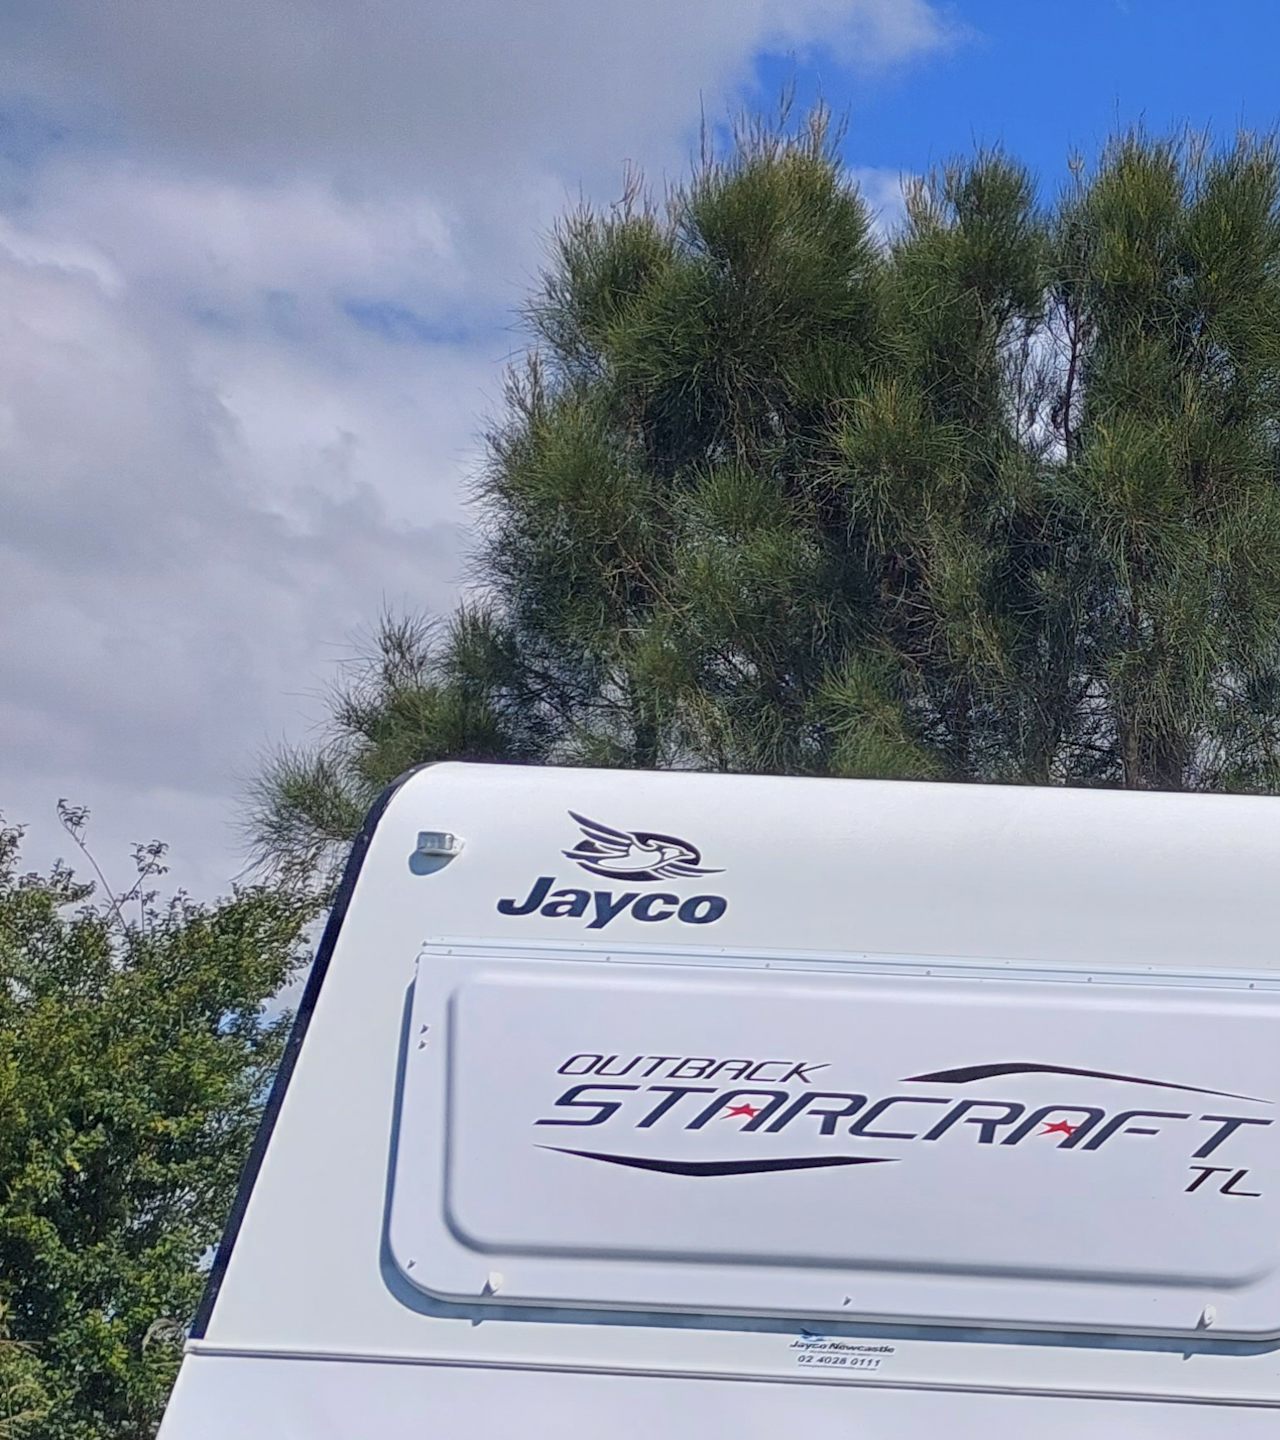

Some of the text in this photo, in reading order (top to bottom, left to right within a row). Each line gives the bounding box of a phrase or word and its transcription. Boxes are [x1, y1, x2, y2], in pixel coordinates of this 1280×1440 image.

[496, 876, 728, 930] Jayco
[556, 1053, 832, 1084] OUTBACK
[532, 1084, 1276, 1159] STARCRAFT
[1184, 1165, 1263, 1197] TL
[789, 1341, 896, 1353] Jayco Newcastle
[797, 1355, 814, 1363] 02
[850, 1357, 881, 1367] 0111
